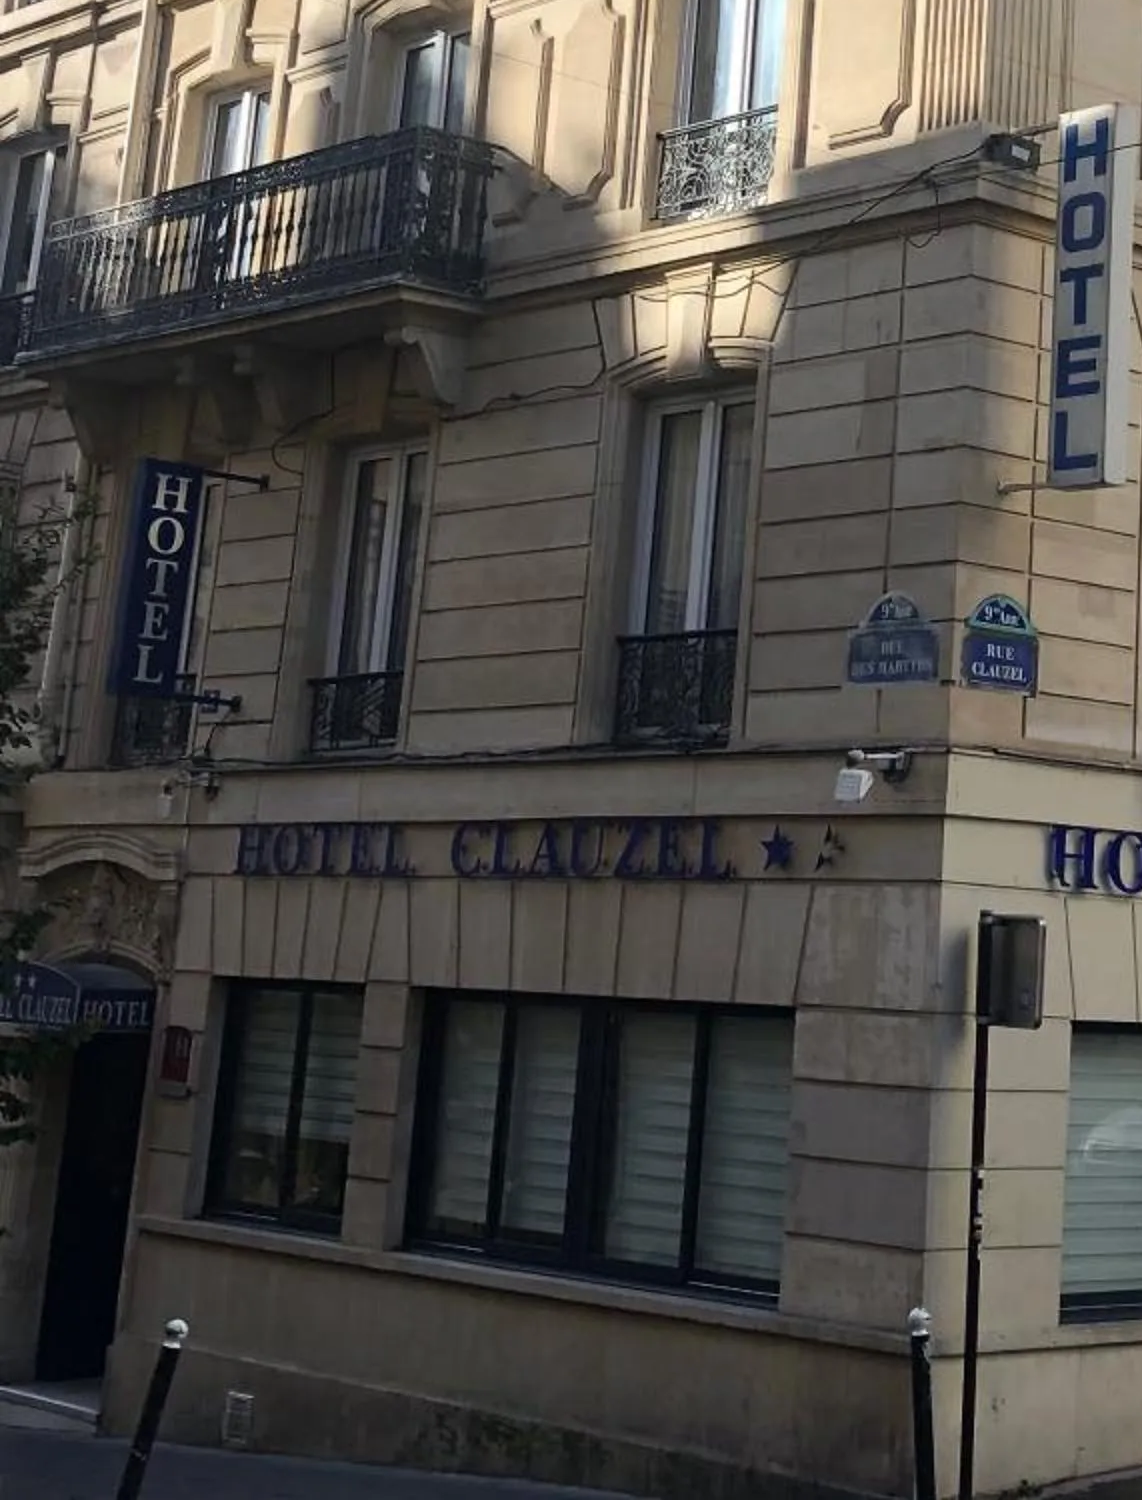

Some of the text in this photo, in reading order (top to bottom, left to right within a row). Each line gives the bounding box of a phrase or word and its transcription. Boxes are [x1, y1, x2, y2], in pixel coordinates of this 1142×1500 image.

[1052, 117, 1110, 472] HOTEL
[132, 472, 193, 684] HOTEL
[971, 663, 1027, 682] CLAUZEL
[987, 643, 1015, 660] RUE
[234, 816, 738, 881] HOTEL CLAUZEL
[83, 999, 150, 1025] HOTEL
